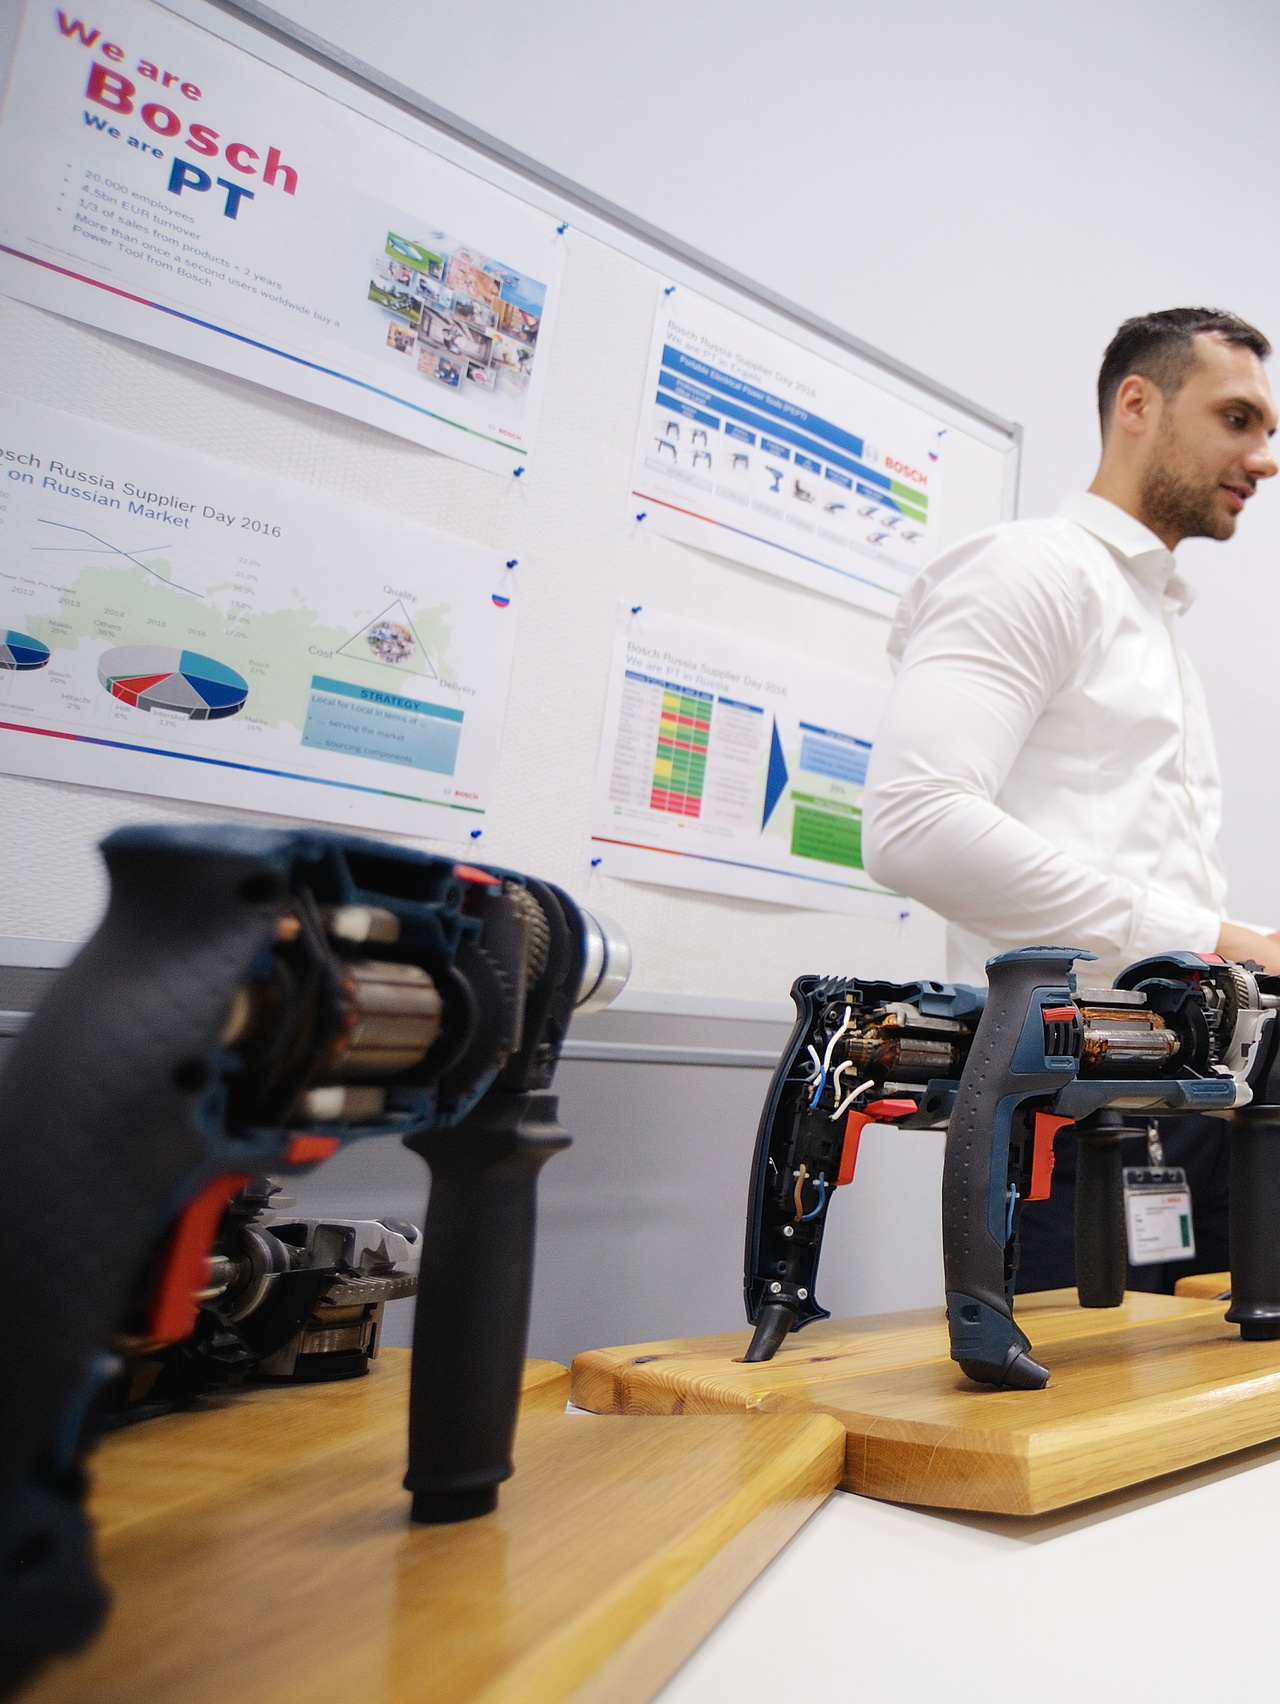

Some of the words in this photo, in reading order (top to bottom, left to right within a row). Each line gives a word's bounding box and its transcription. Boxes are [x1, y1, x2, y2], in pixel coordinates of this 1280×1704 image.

[57, 8, 125, 62] We
[137, 58, 202, 102] are
[83, 110, 121, 140] We
[127, 135, 164, 159] are
[85, 60, 298, 196] Bosch
[85, 170, 128, 194] 20.000
[131, 192, 195, 224] employees
[167, 156, 255, 221] PT
[122, 201, 150, 219] EUR
[153, 215, 201, 240] turnover
[72, 225, 112, 247] Power
[119, 243, 143, 259] Tool
[146, 254, 173, 272] from
[177, 267, 212, 287] Bosch
[79, 199, 98, 212] 1/3
[102, 209, 115, 219] of
[118, 216, 149, 234] sales
[153, 230, 179, 246] from
[182, 243, 231, 268] products
[244, 268, 251, 276] 2
[253, 273, 282, 290] years
[75, 213, 108, 232] More
[111, 228, 139, 245] than
[142, 242, 171, 258] once
[185, 259, 225, 280] second
[228, 277, 258, 294] users
[260, 291, 311, 316] worldwide
[314, 311, 332, 325] buy
[666, 331, 683, 345] We
[685, 341, 700, 353] are
[704, 350, 717, 363] PT
[720, 356, 728, 367] in
[668, 320, 698, 341] Bosch
[701, 336, 732, 359] Russia
[736, 354, 773, 377] Supplier
[776, 371, 794, 388] Day
[885, 456, 928, 486] BOSCH
[8, 470, 34, 485] on
[42, 476, 121, 509] Russian
[128, 500, 191, 530] Market
[49, 460, 115, 490] Russia
[123, 482, 197, 514] Supplier
[202, 505, 236, 527] Day
[241, 518, 282, 539] 2016
[383, 584, 417, 603] Quality
[308, 645, 334, 660] Cost
[626, 655, 643, 667] We
[646, 662, 663, 674] are
[667, 666, 681, 678] PT
[684, 672, 693, 682] in
[696, 676, 729, 692] Russia
[627, 641, 660, 659] Bosch
[663, 652, 698, 670] Russia
[701, 663, 741, 682] Supplier
[743, 675, 762, 690] Day
[765, 682, 788, 697] 2016
[311, 694, 336, 707] Local
[337, 700, 349, 709] for
[351, 704, 374, 716] Local
[375, 708, 383, 717] in
[384, 711, 407, 723] terms
[360, 690, 421, 711] STRATEGY
[439, 678, 477, 697] Delivery
[325, 739, 362, 754] sourcing
[364, 747, 413, 763] components
[329, 720, 360, 734] serving
[361, 725, 375, 735] the
[377, 731, 405, 743] market
[454, 789, 480, 801] BOSCH
